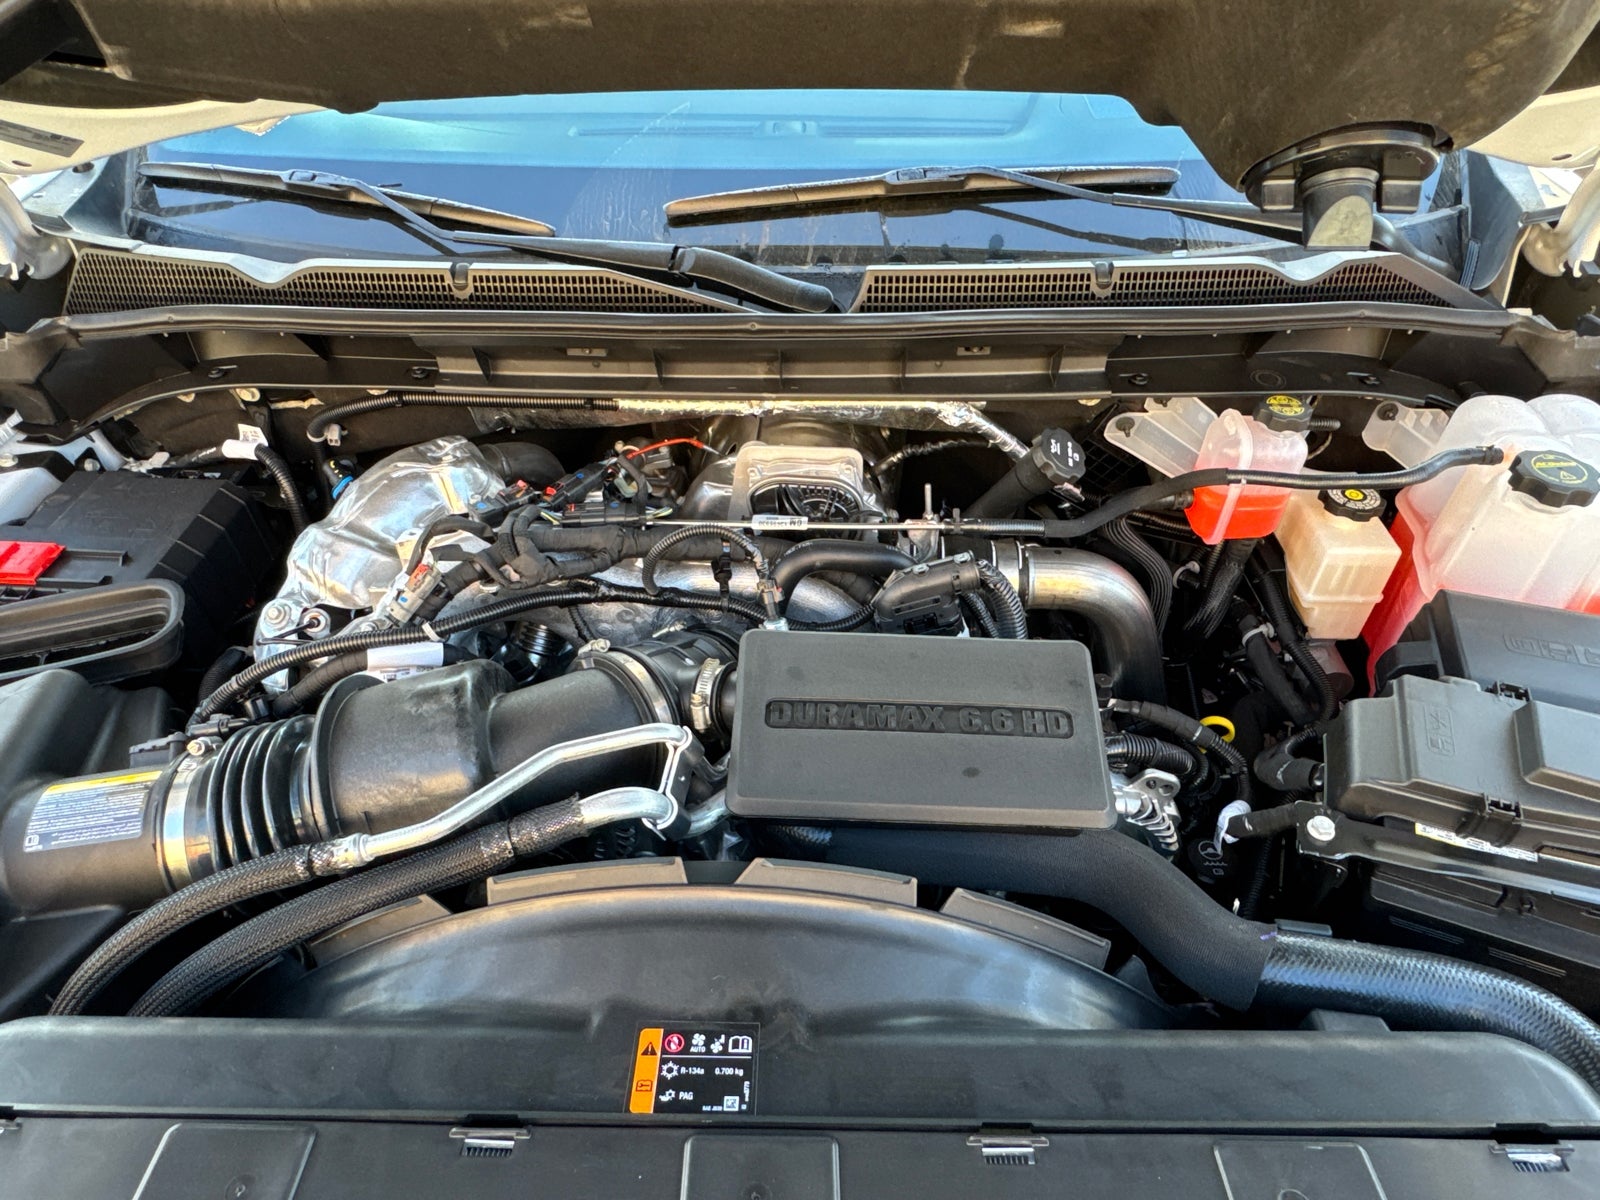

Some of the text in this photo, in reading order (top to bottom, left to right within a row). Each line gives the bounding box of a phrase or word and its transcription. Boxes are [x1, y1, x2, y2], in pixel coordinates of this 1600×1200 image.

[770, 701, 1072, 737] DURAMAX 6.6 HD
[680, 1067, 744, 1077] R-134a 0.700 kg
[679, 1091, 694, 1100] PAG
